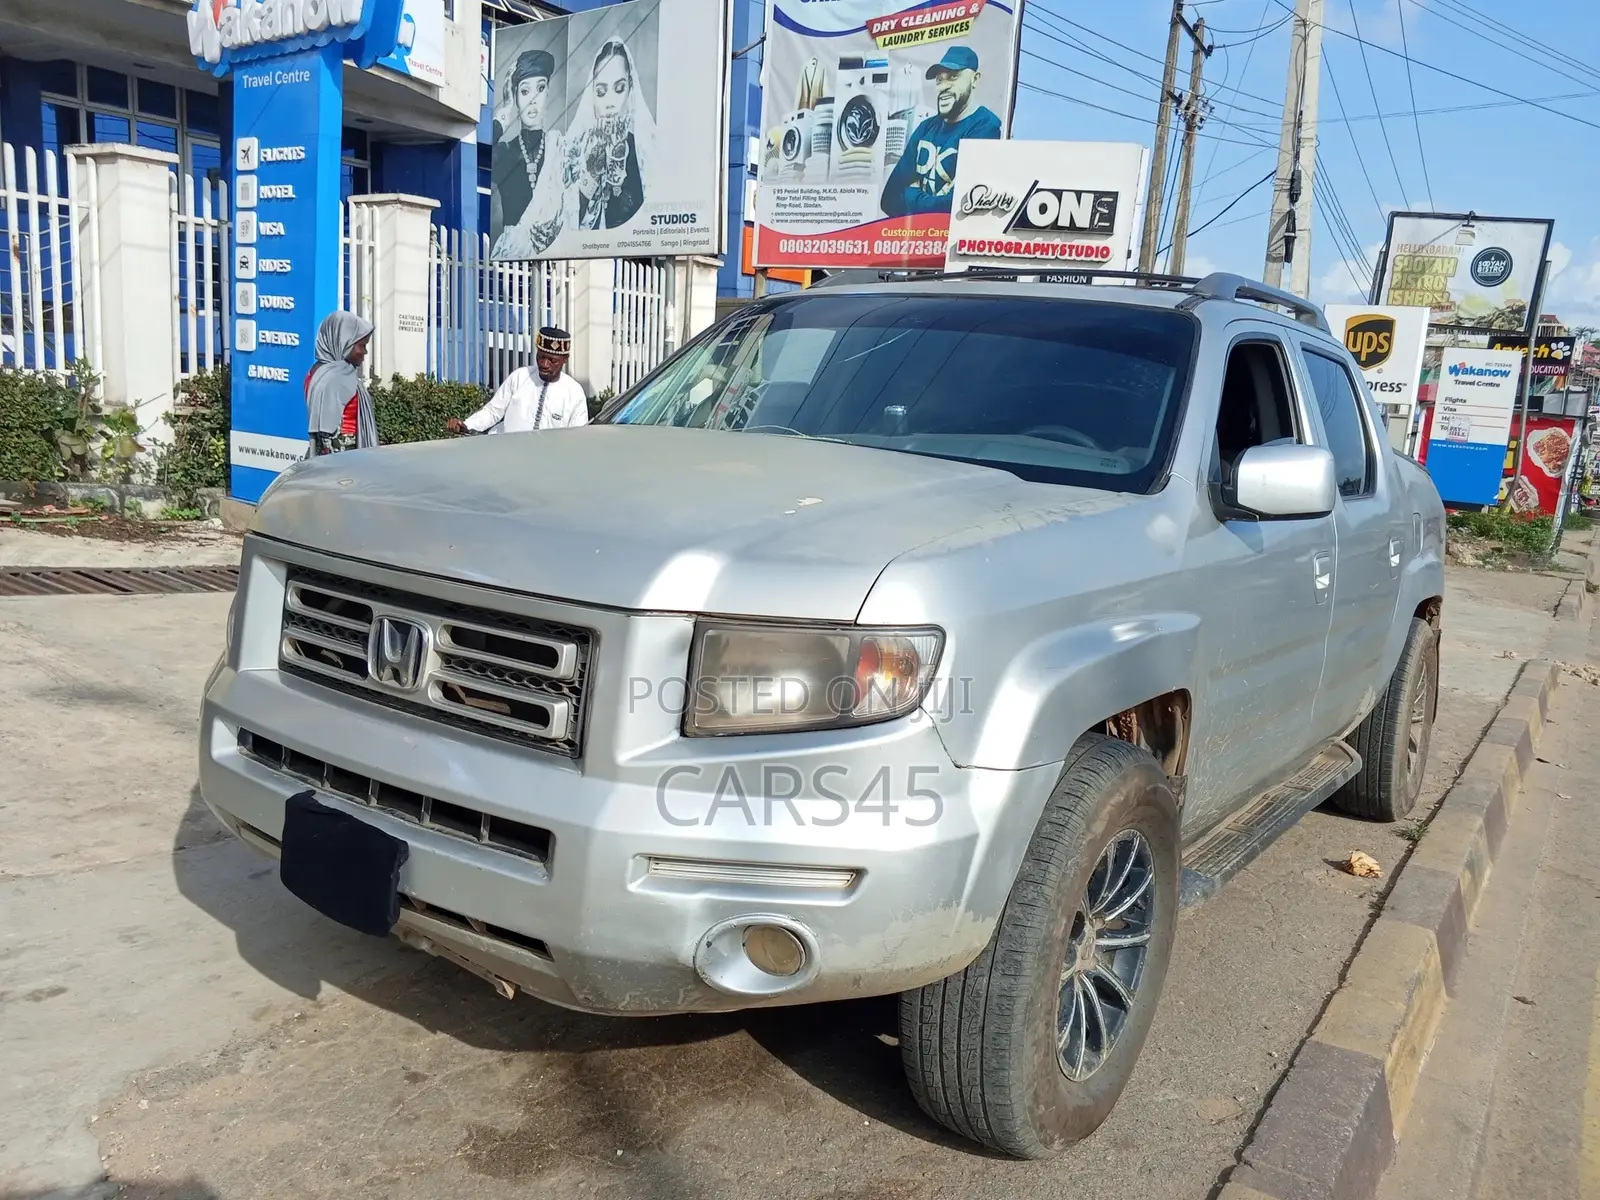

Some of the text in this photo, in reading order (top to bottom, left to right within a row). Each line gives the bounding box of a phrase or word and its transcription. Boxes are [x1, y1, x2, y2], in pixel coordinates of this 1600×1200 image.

[872, 4, 979, 34] DRY CLEANING &
[187, 0, 362, 64] Wakanow
[883, 20, 970, 47] LAUNDRY SERVICES
[408, 58, 443, 77] Travel Centre
[242, 69, 310, 89] Travel Centre
[260, 146, 305, 162] FLIGHTS
[260, 185, 296, 199] HOTEL
[650, 213, 697, 225] STUDIOS
[259, 222, 286, 236] VISA
[633, 226, 709, 236] Portraits Editorials Events
[881, 227, 949, 237] Customer Care
[661, 240, 679, 248] Sango
[683, 238, 709, 246] Ringroad
[874, 240, 949, 255] 080273384
[259, 259, 291, 273] RIDES
[1394, 255, 1456, 274] SOOYAH
[1477, 266, 1505, 274] BISTRO
[1478, 260, 1507, 268] SOOYAH
[1046, 275, 1087, 284] FASHION
[258, 295, 295, 310] TOURS
[259, 330, 300, 346] EVENTS
[1347, 332, 1390, 361] ups
[1448, 364, 1511, 378] Wakanow
[1454, 379, 1500, 388] Travel Centre
[1444, 396, 1467, 404] Flights
[238, 445, 304, 462] www.wakanow.c
